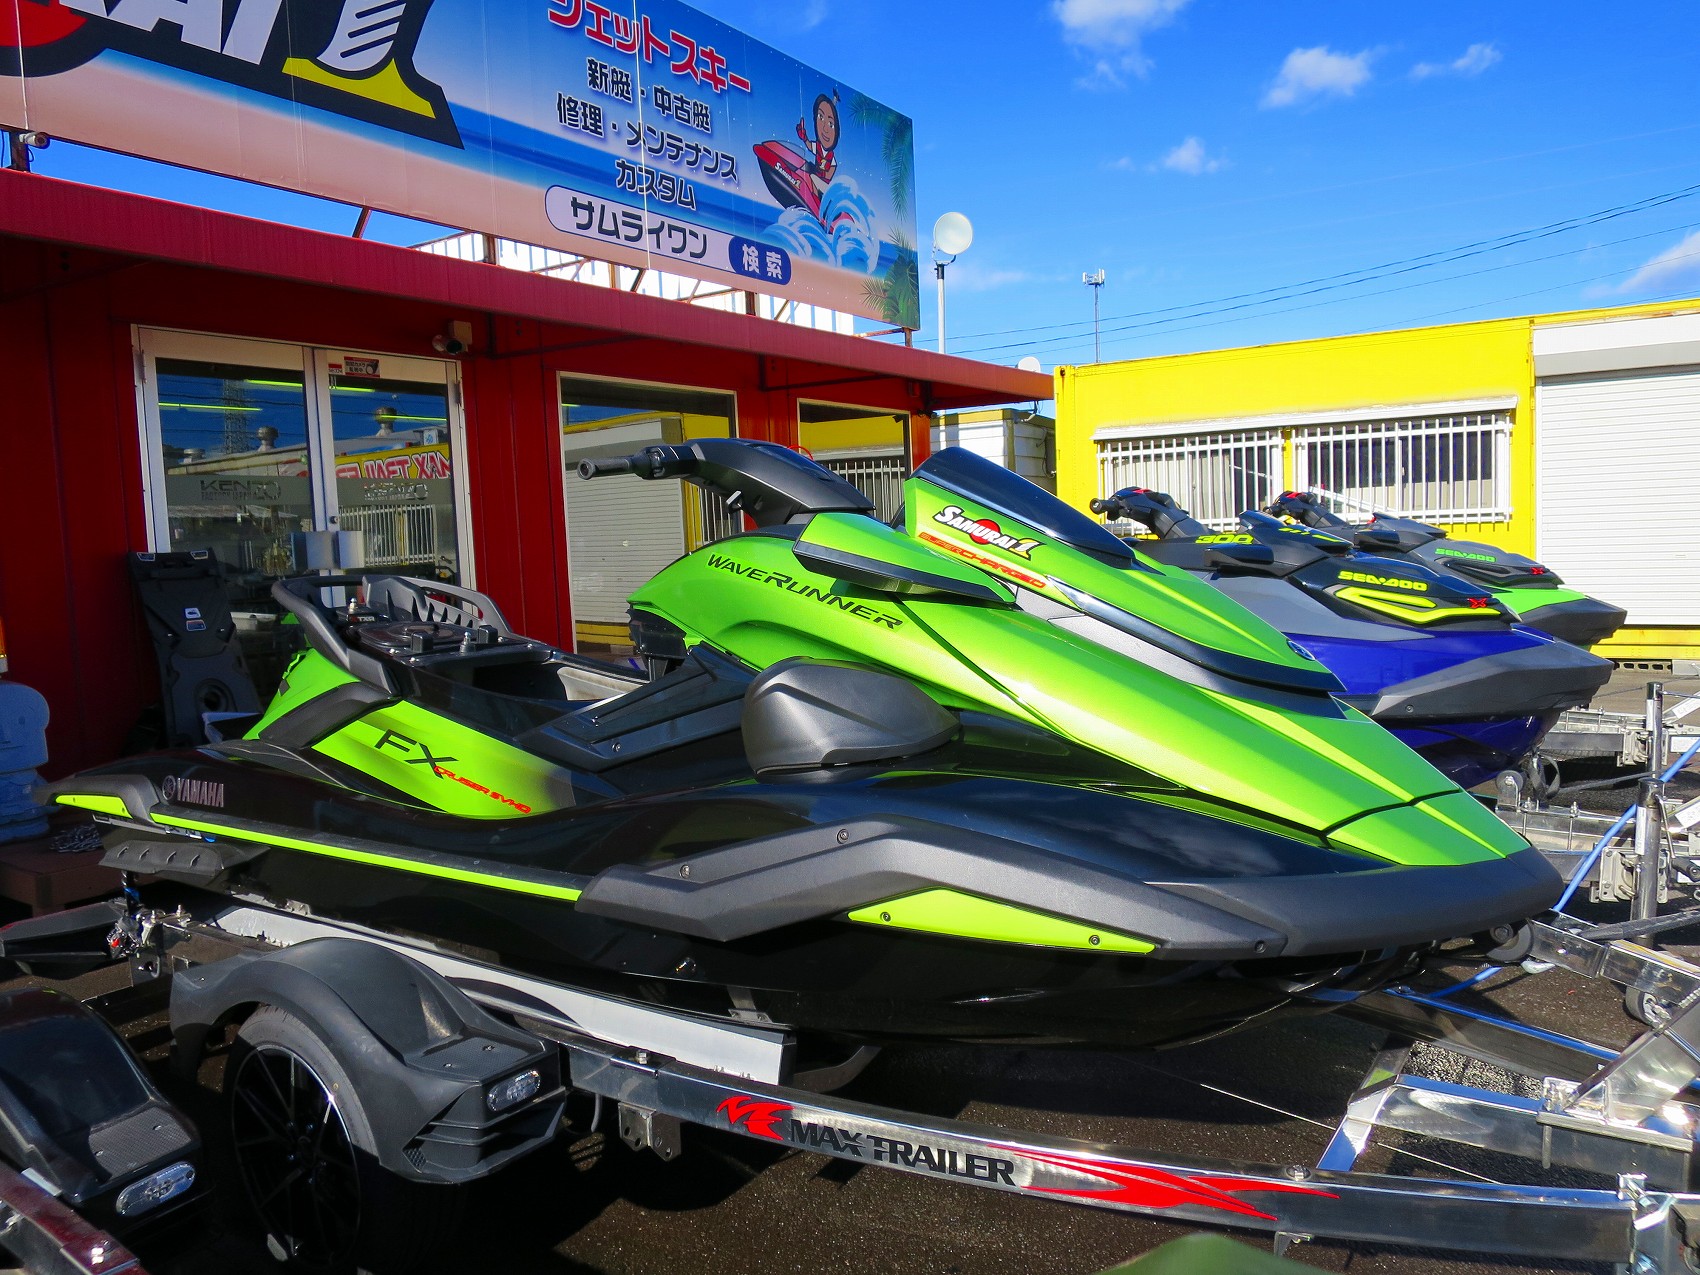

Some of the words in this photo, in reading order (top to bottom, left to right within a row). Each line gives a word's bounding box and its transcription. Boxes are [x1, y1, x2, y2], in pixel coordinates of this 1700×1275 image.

[587, 57, 711, 132] 新艇・中古艇
[557, 92, 738, 181] 修理・メンテナンス
[615, 159, 696, 210] カスタム
[571, 196, 708, 259] サムライワン
[742, 243, 783, 280] 検索
[933, 505, 1018, 550] SAMURAI
[918, 531, 1047, 589] SUPERCHARGED
[706, 553, 904, 630] WAVERUNNER
[374, 728, 459, 780] FX
[177, 777, 225, 808] YAMAHA
[790, 1119, 865, 1157] MAX
[867, 1134, 1016, 1186] TRAILER
